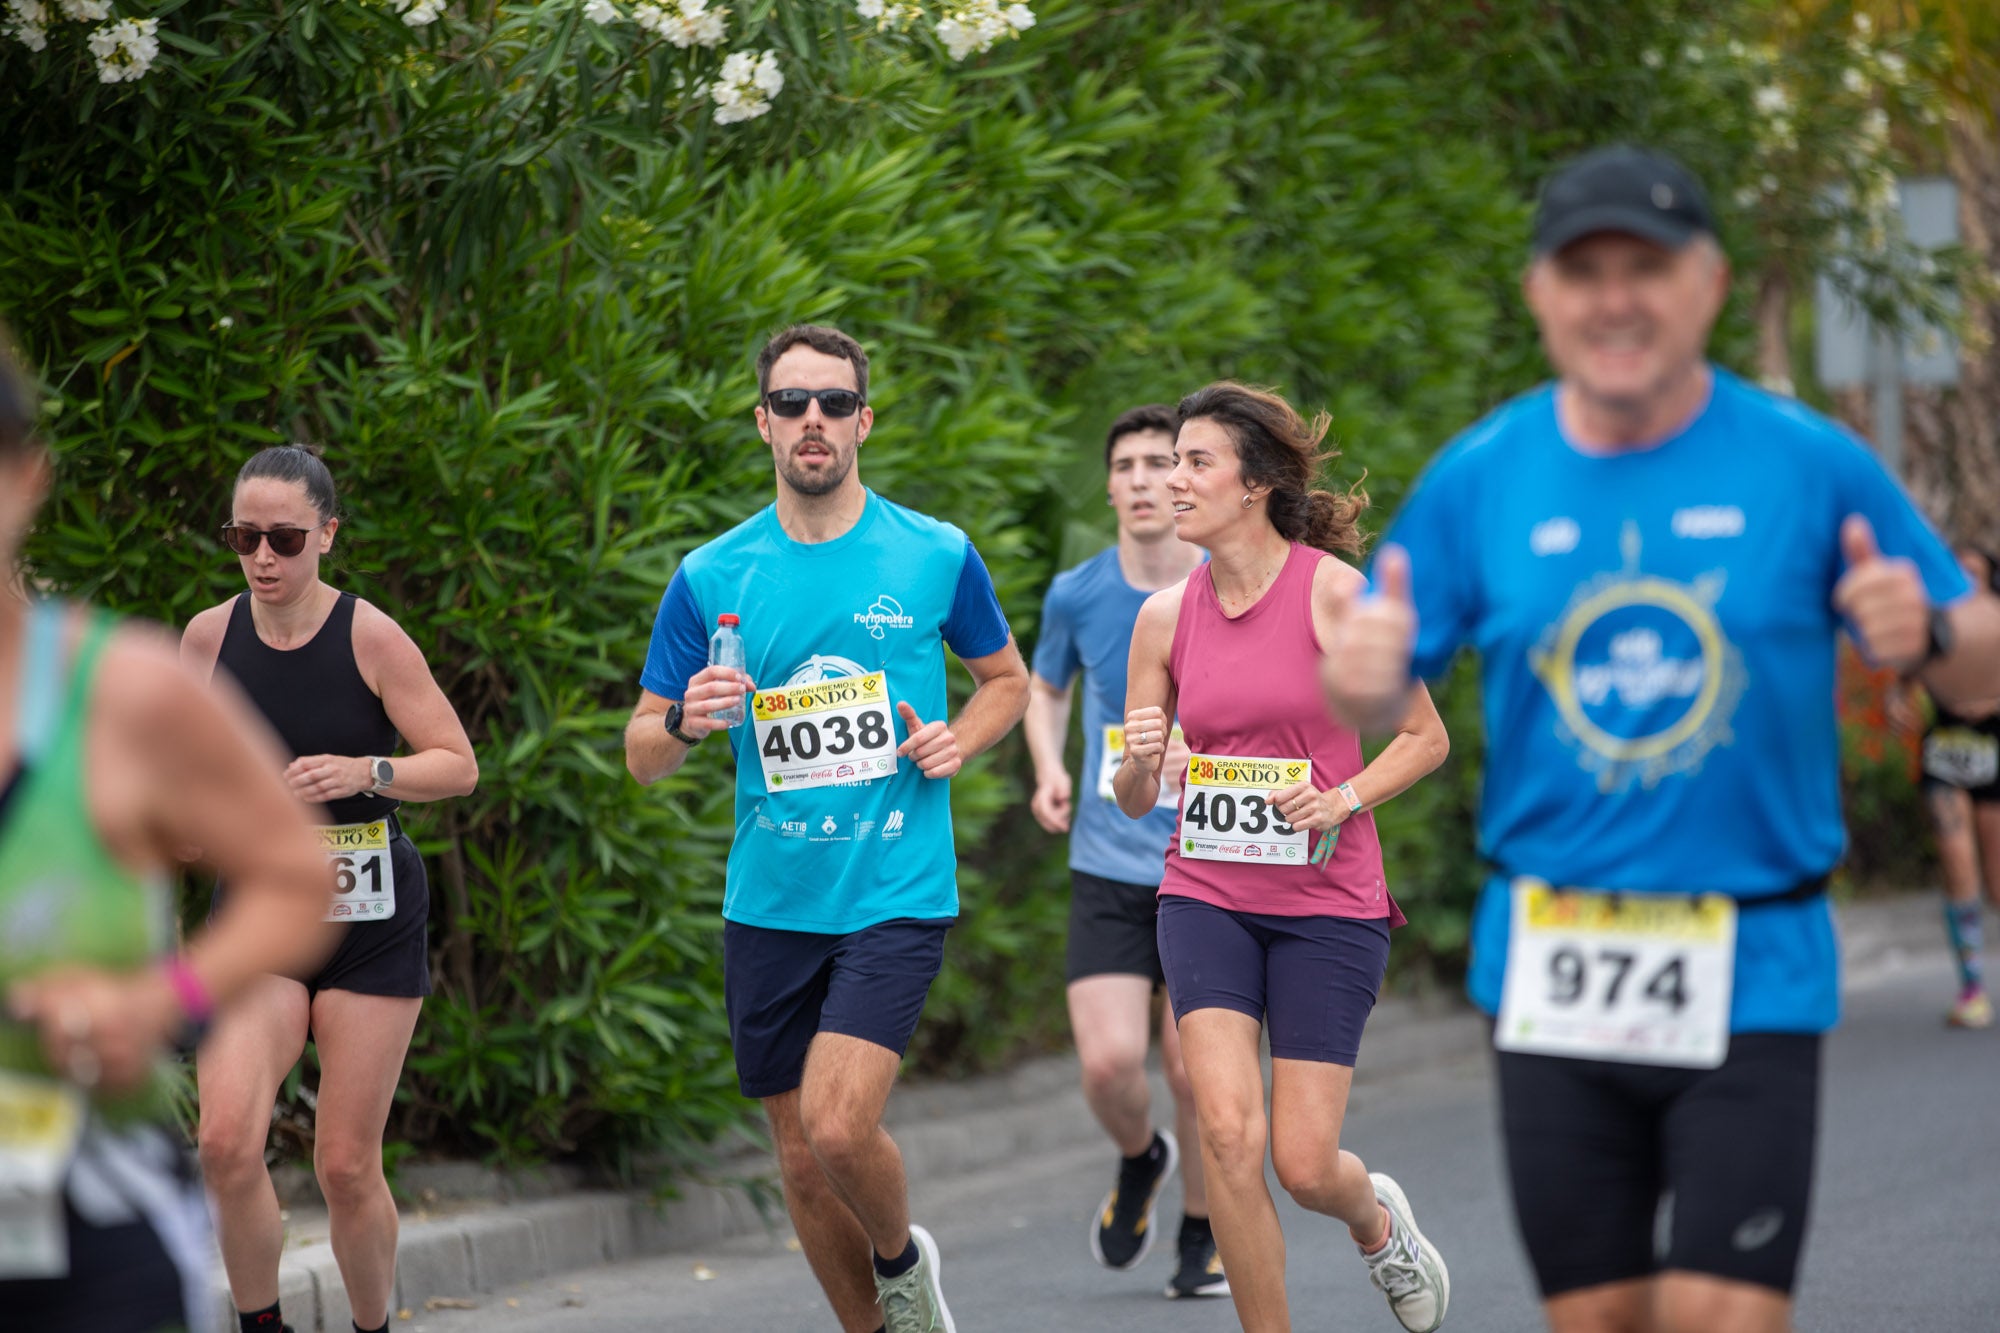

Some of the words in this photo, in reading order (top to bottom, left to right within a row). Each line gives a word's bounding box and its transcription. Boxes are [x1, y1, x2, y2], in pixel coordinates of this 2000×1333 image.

[853, 613, 913, 625] Formentera
[789, 688, 815, 698] GRAN
[816, 681, 850, 693] PREMIO
[765, 694, 788, 712] 38
[787, 687, 858, 710] FONDO
[762, 710, 889, 763] 4038
[1199, 761, 1214, 779] 38
[1217, 761, 1240, 769] GRAN
[1242, 762, 1274, 770] PREMIO
[1214, 767, 1280, 784] FONDO
[781, 820, 808, 833] AETIB
[1547, 944, 1692, 1013] 974
